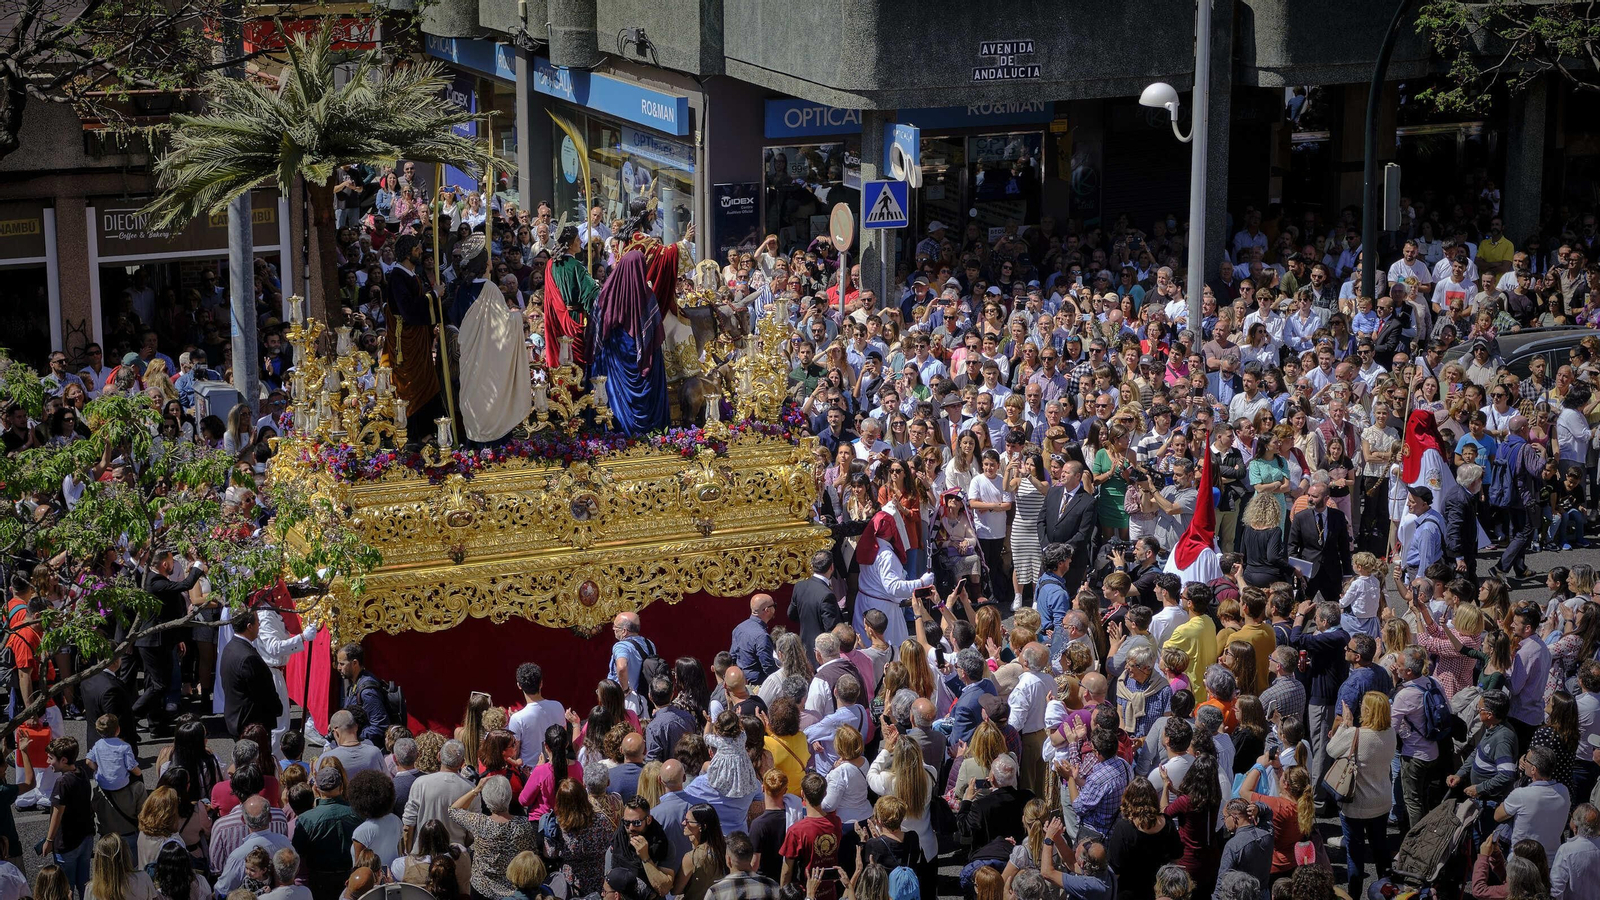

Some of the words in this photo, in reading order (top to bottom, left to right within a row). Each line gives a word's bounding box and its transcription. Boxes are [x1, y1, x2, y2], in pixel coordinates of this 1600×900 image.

[981, 42, 1034, 55] AVENIDA
[1000, 55, 1014, 66] DE
[974, 66, 1040, 80] ANDALUCIA
[641, 98, 675, 123] RO&MAN
[967, 100, 1045, 116] RO&MAN
[721, 196, 754, 207] WIDEX
[119, 231, 138, 240] Coffee
[140, 230, 146, 238] &
